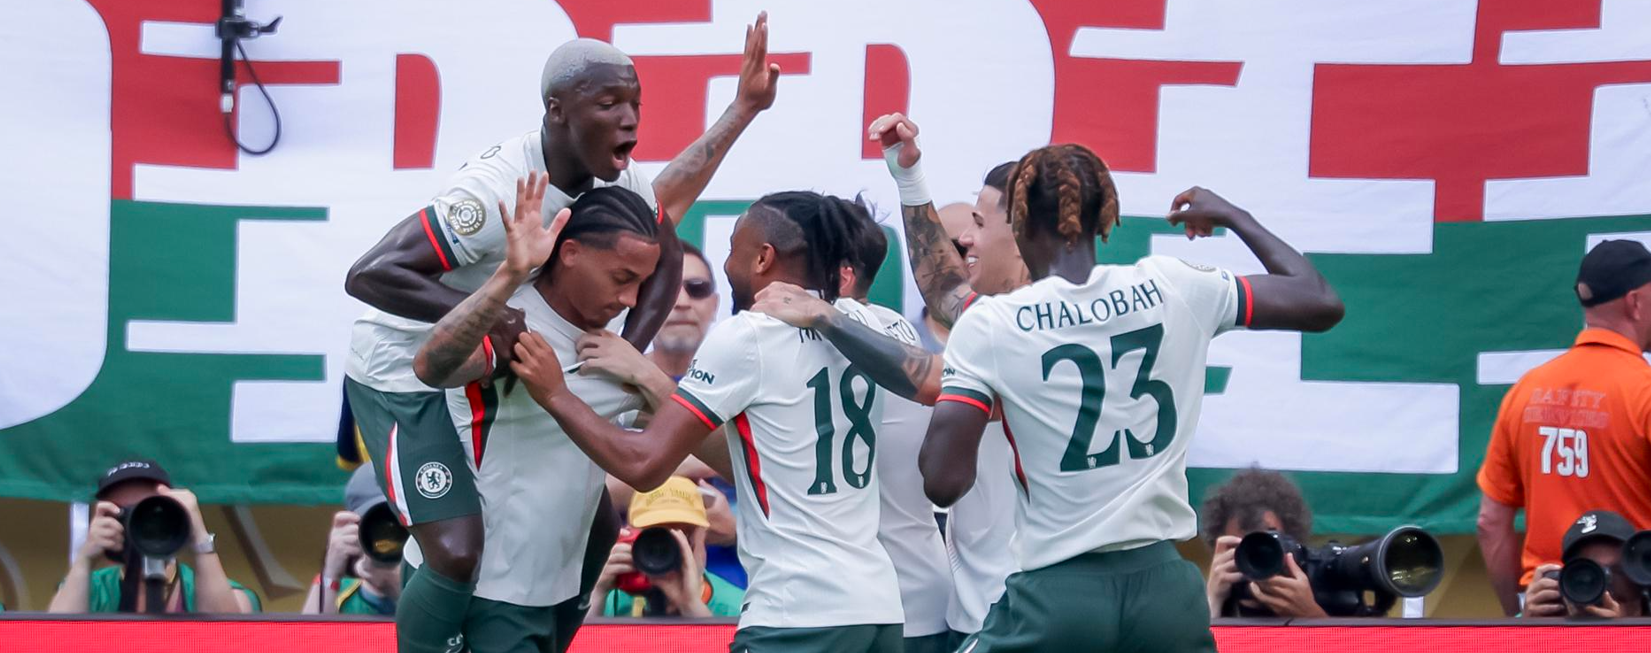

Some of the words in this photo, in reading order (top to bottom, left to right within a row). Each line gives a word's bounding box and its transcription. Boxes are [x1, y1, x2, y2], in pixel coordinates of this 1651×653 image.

[1016, 278, 1164, 332] CHALOBAH
[806, 359, 877, 495] 18
[1041, 322, 1178, 472] 23
[1538, 426, 1589, 478] 759
